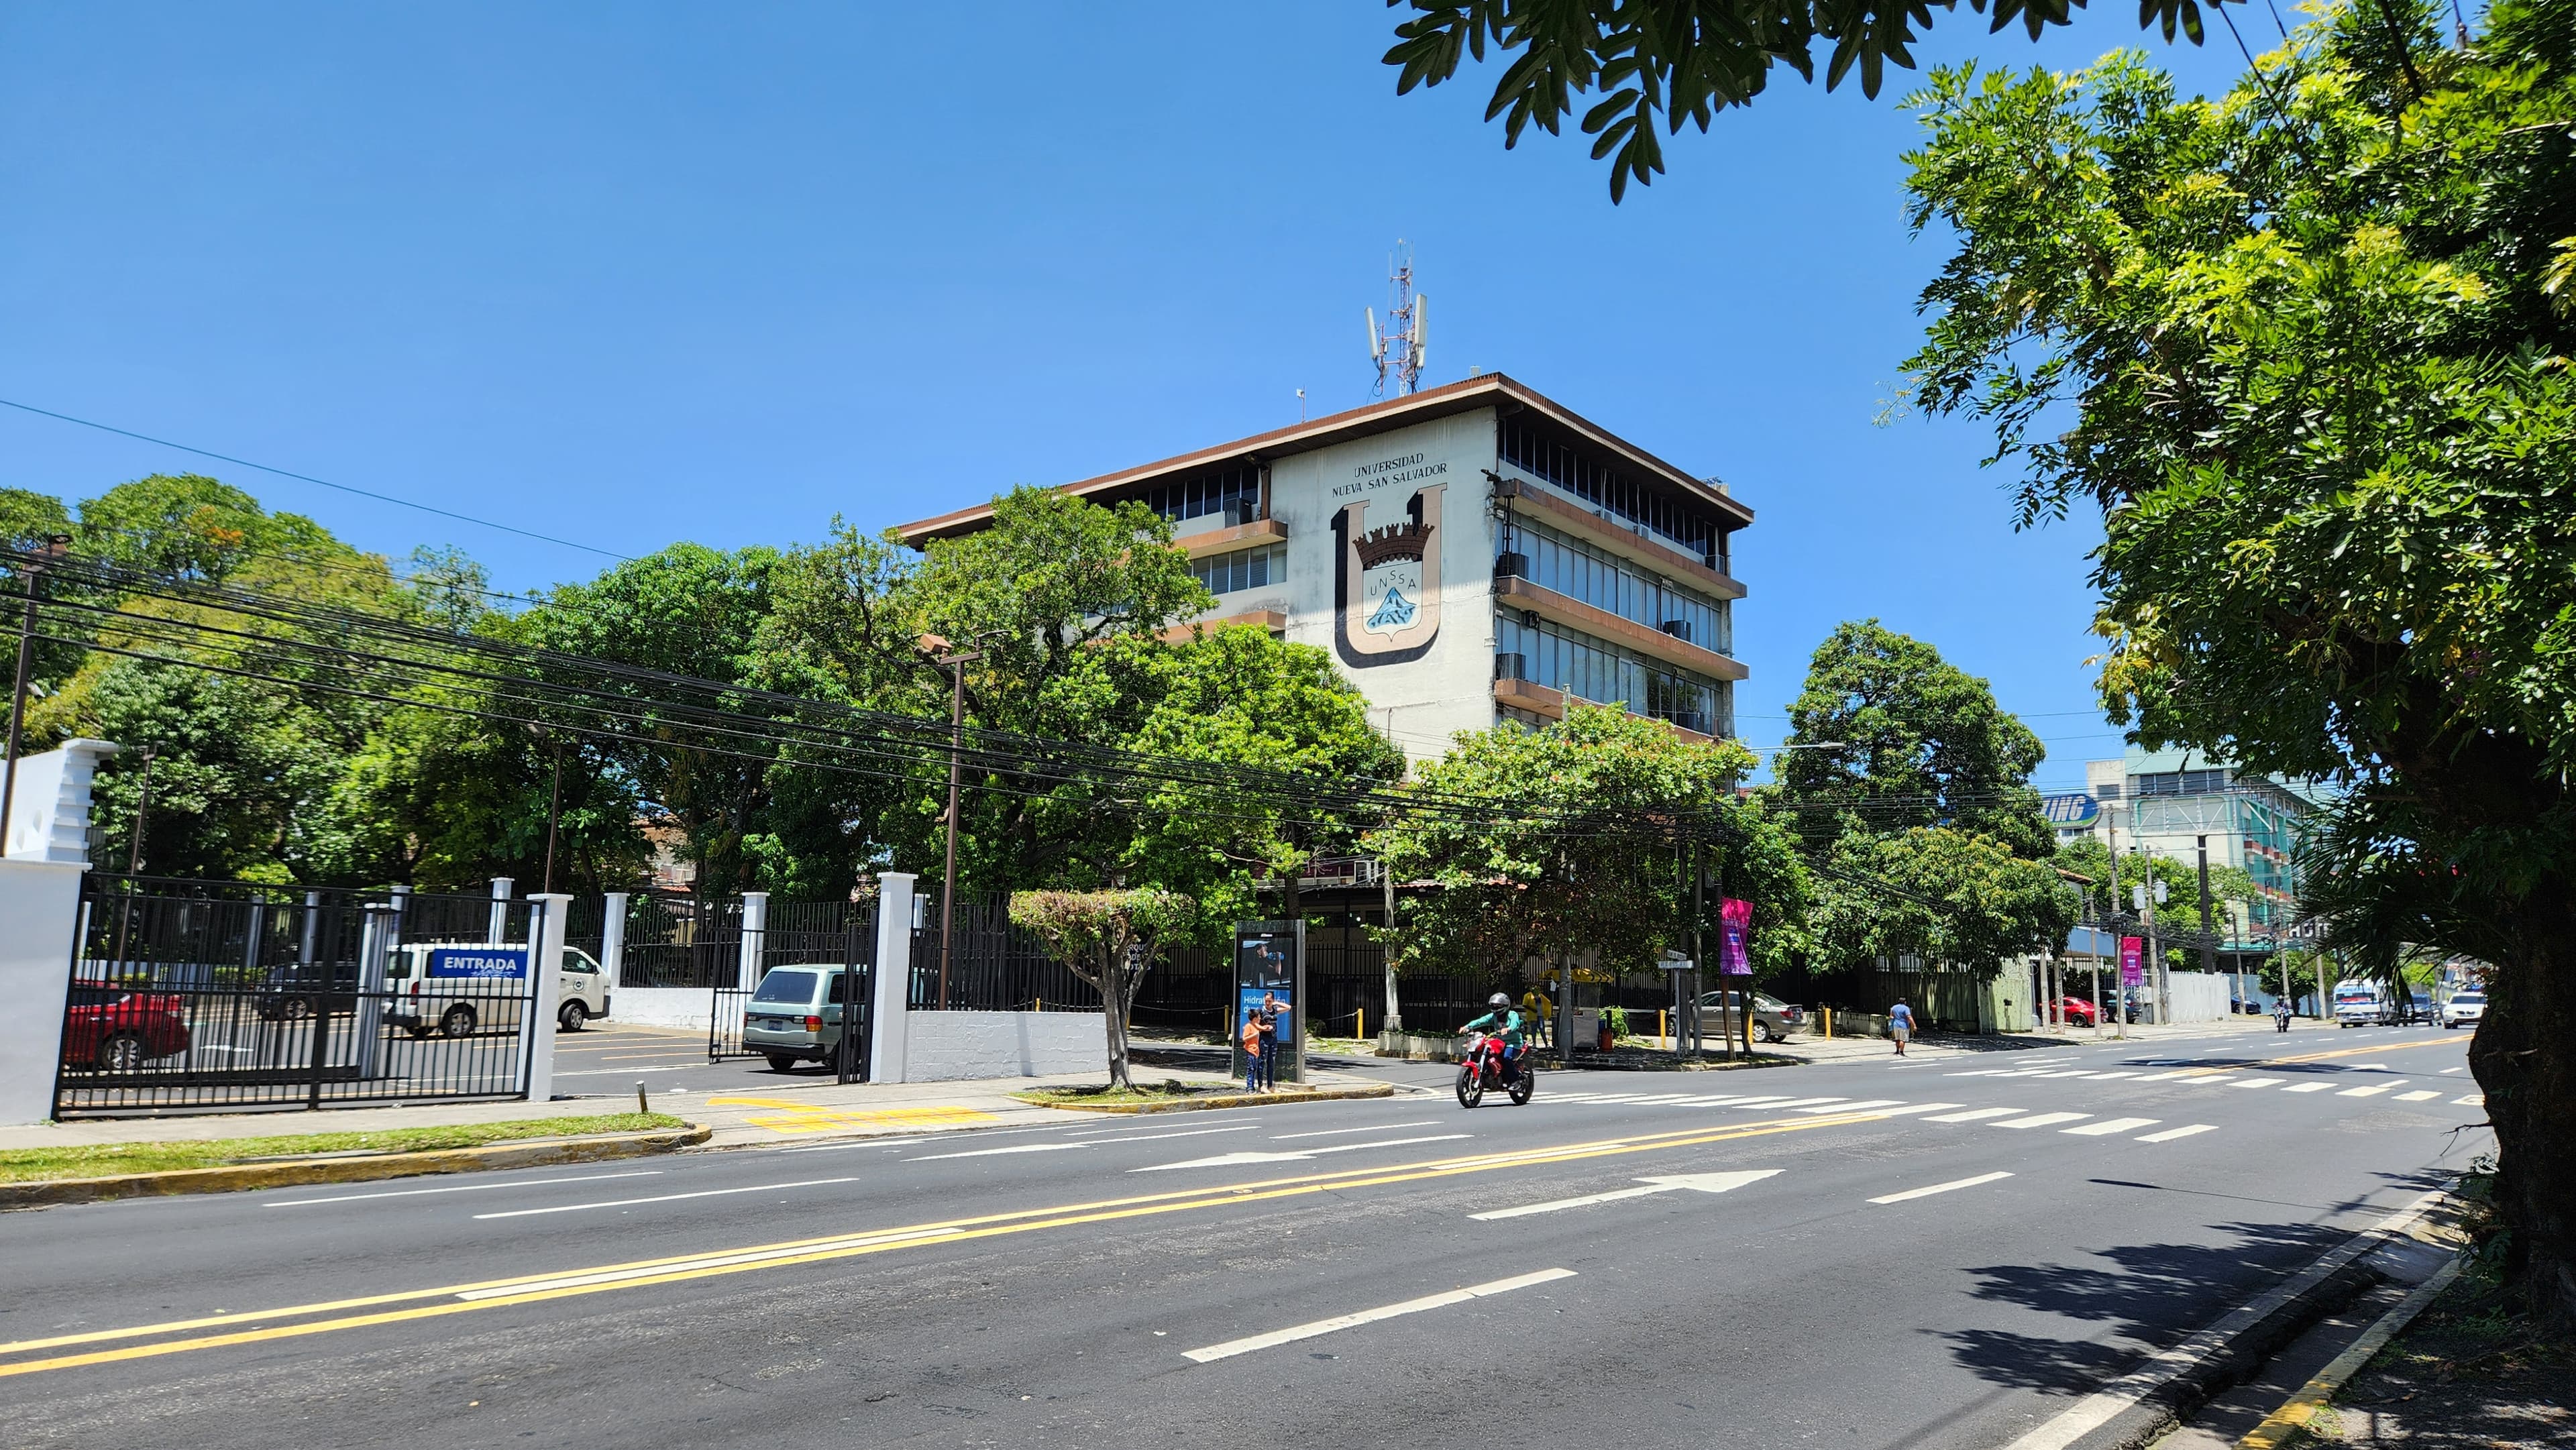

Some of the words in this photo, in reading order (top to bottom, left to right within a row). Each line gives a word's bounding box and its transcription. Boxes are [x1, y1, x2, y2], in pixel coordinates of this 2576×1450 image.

[1354, 452, 1424, 478] UNIVERSIDAD
[1332, 482, 1362, 498] NUEVA
[1368, 476, 1389, 490] SAN
[1393, 463, 1447, 484] SALVADOR
[1370, 570, 1417, 596] UNSSA
[443, 956, 517, 970] ENTRADA
